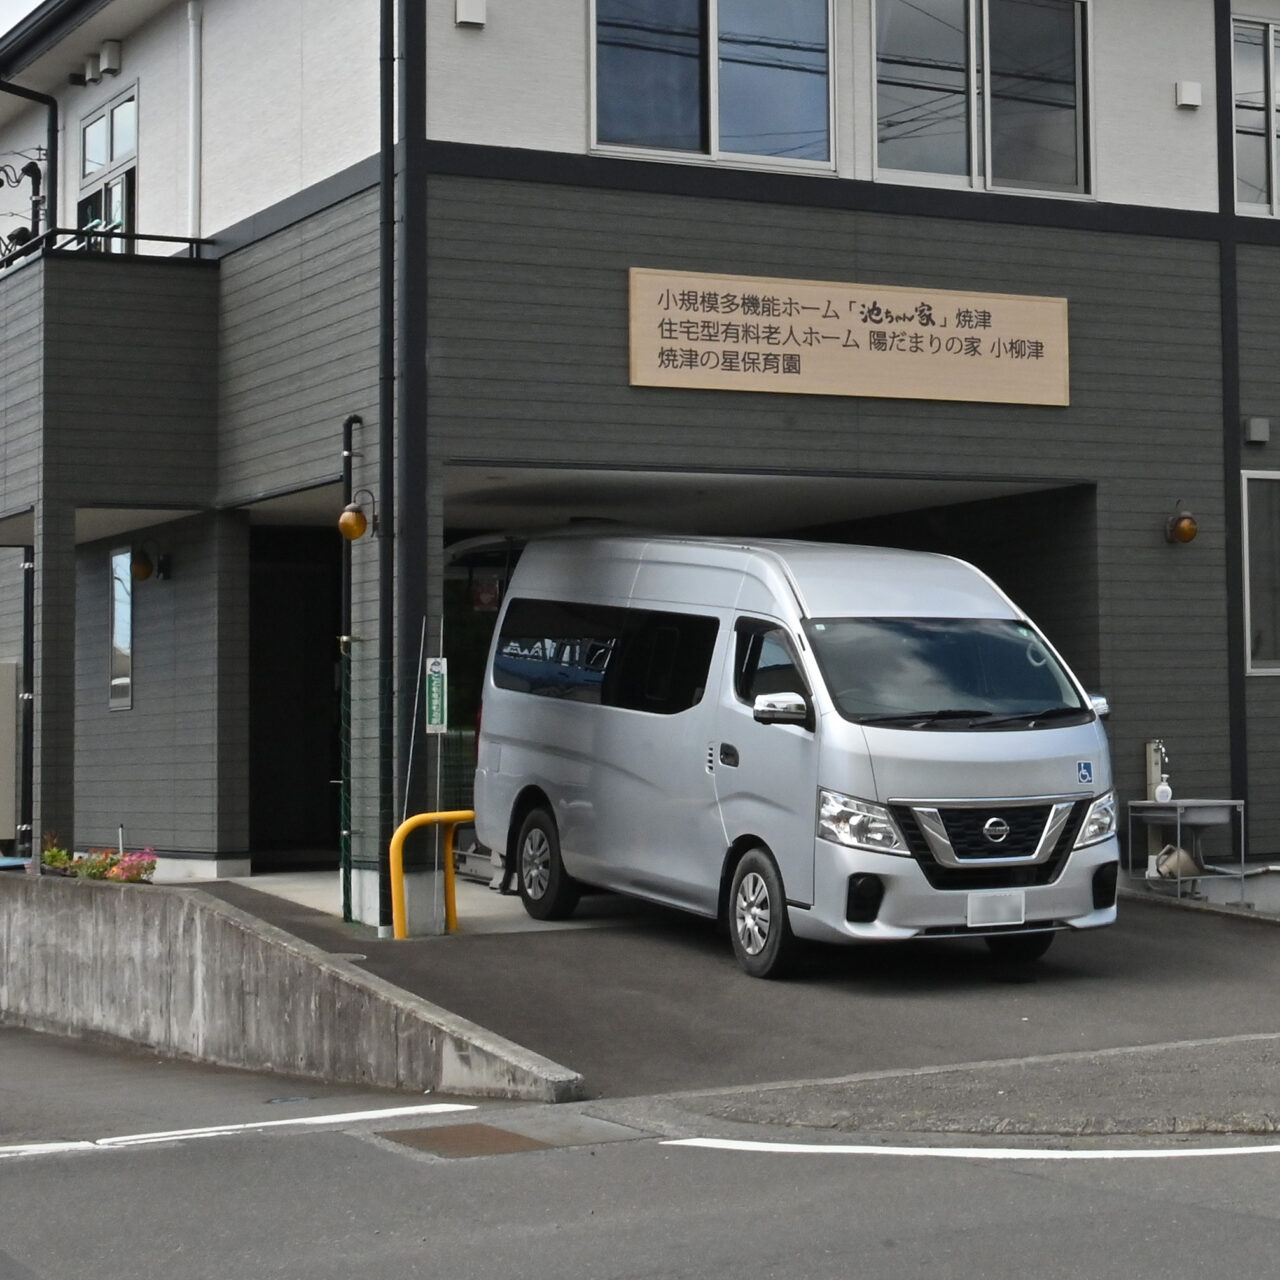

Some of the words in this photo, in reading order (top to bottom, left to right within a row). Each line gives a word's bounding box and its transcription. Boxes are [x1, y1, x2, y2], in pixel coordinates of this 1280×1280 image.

[657, 317, 860, 349] 住宅型有料老人ホーム
[869, 330, 982, 357] 陽だまりの家
[990, 337, 1044, 360] 小柳津
[658, 346, 801, 375] 焼津の星保育園
